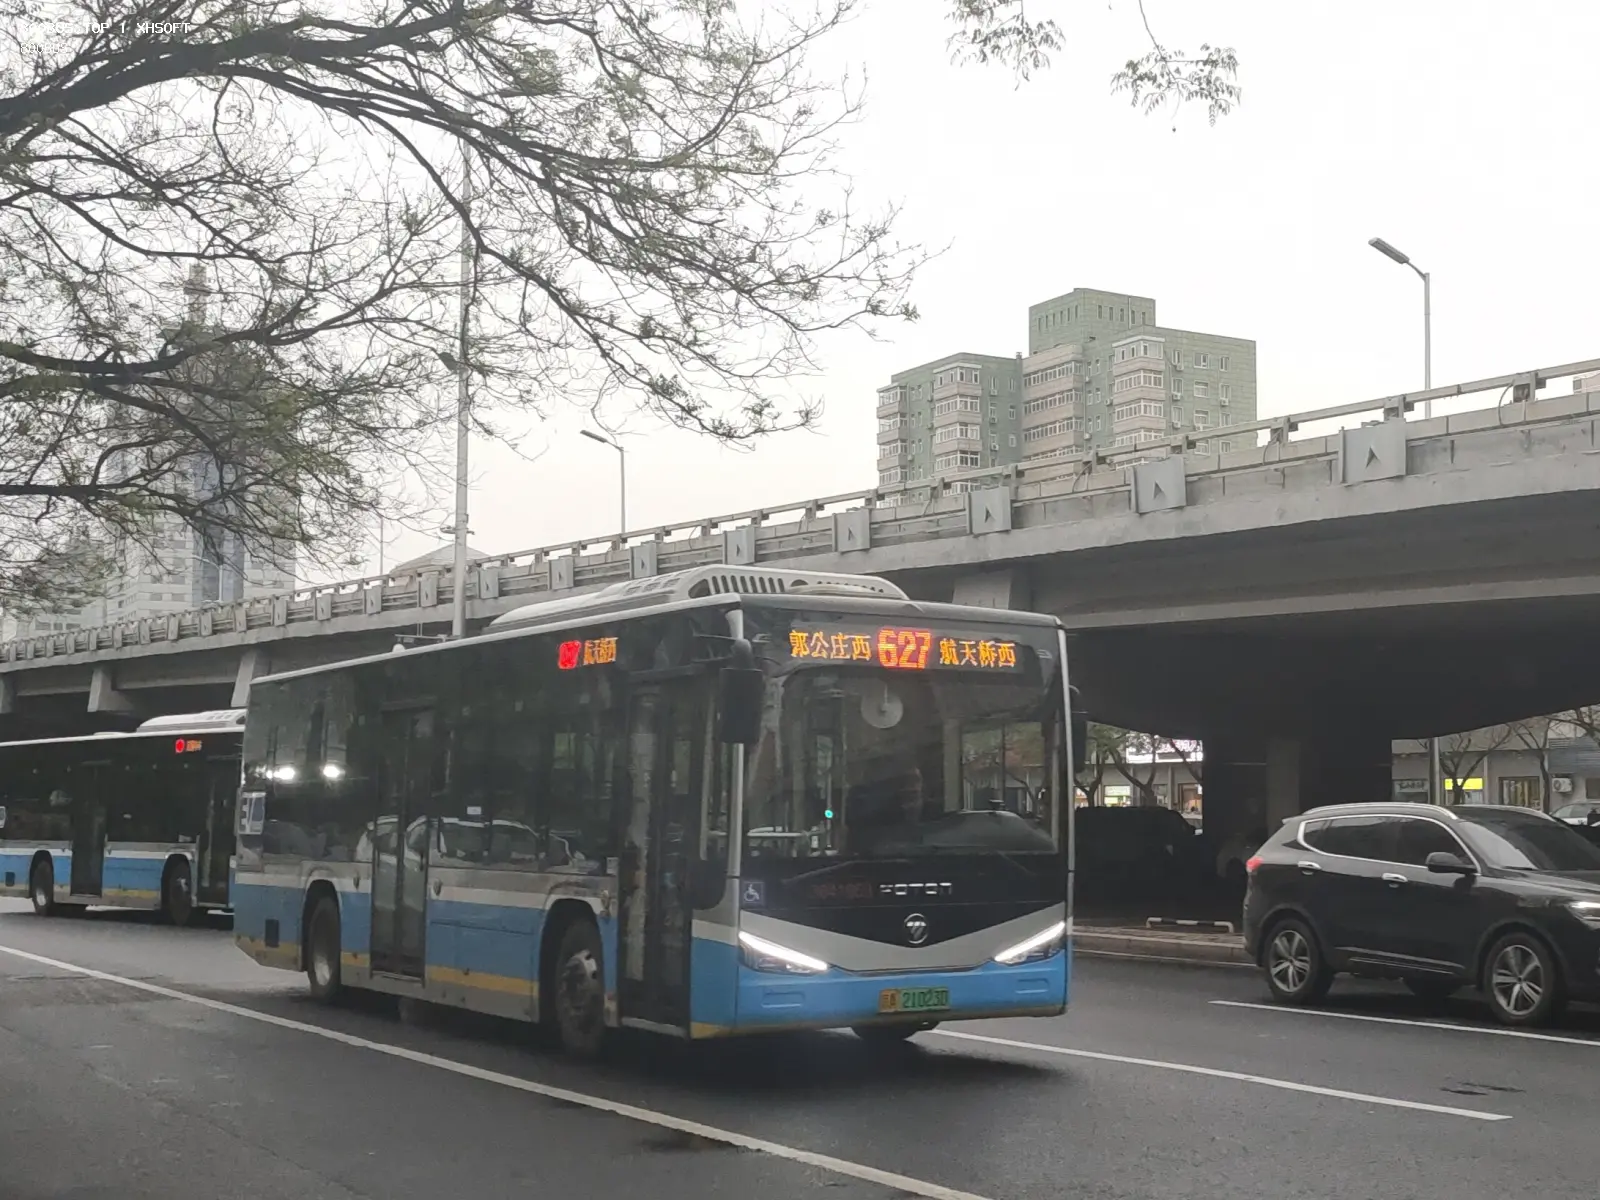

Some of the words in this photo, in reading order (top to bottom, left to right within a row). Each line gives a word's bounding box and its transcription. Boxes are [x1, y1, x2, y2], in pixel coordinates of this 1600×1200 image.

[789, 629, 872, 661] 郭公庄西
[876, 628, 932, 670] 627
[939, 637, 1016, 668] 航天桥西
